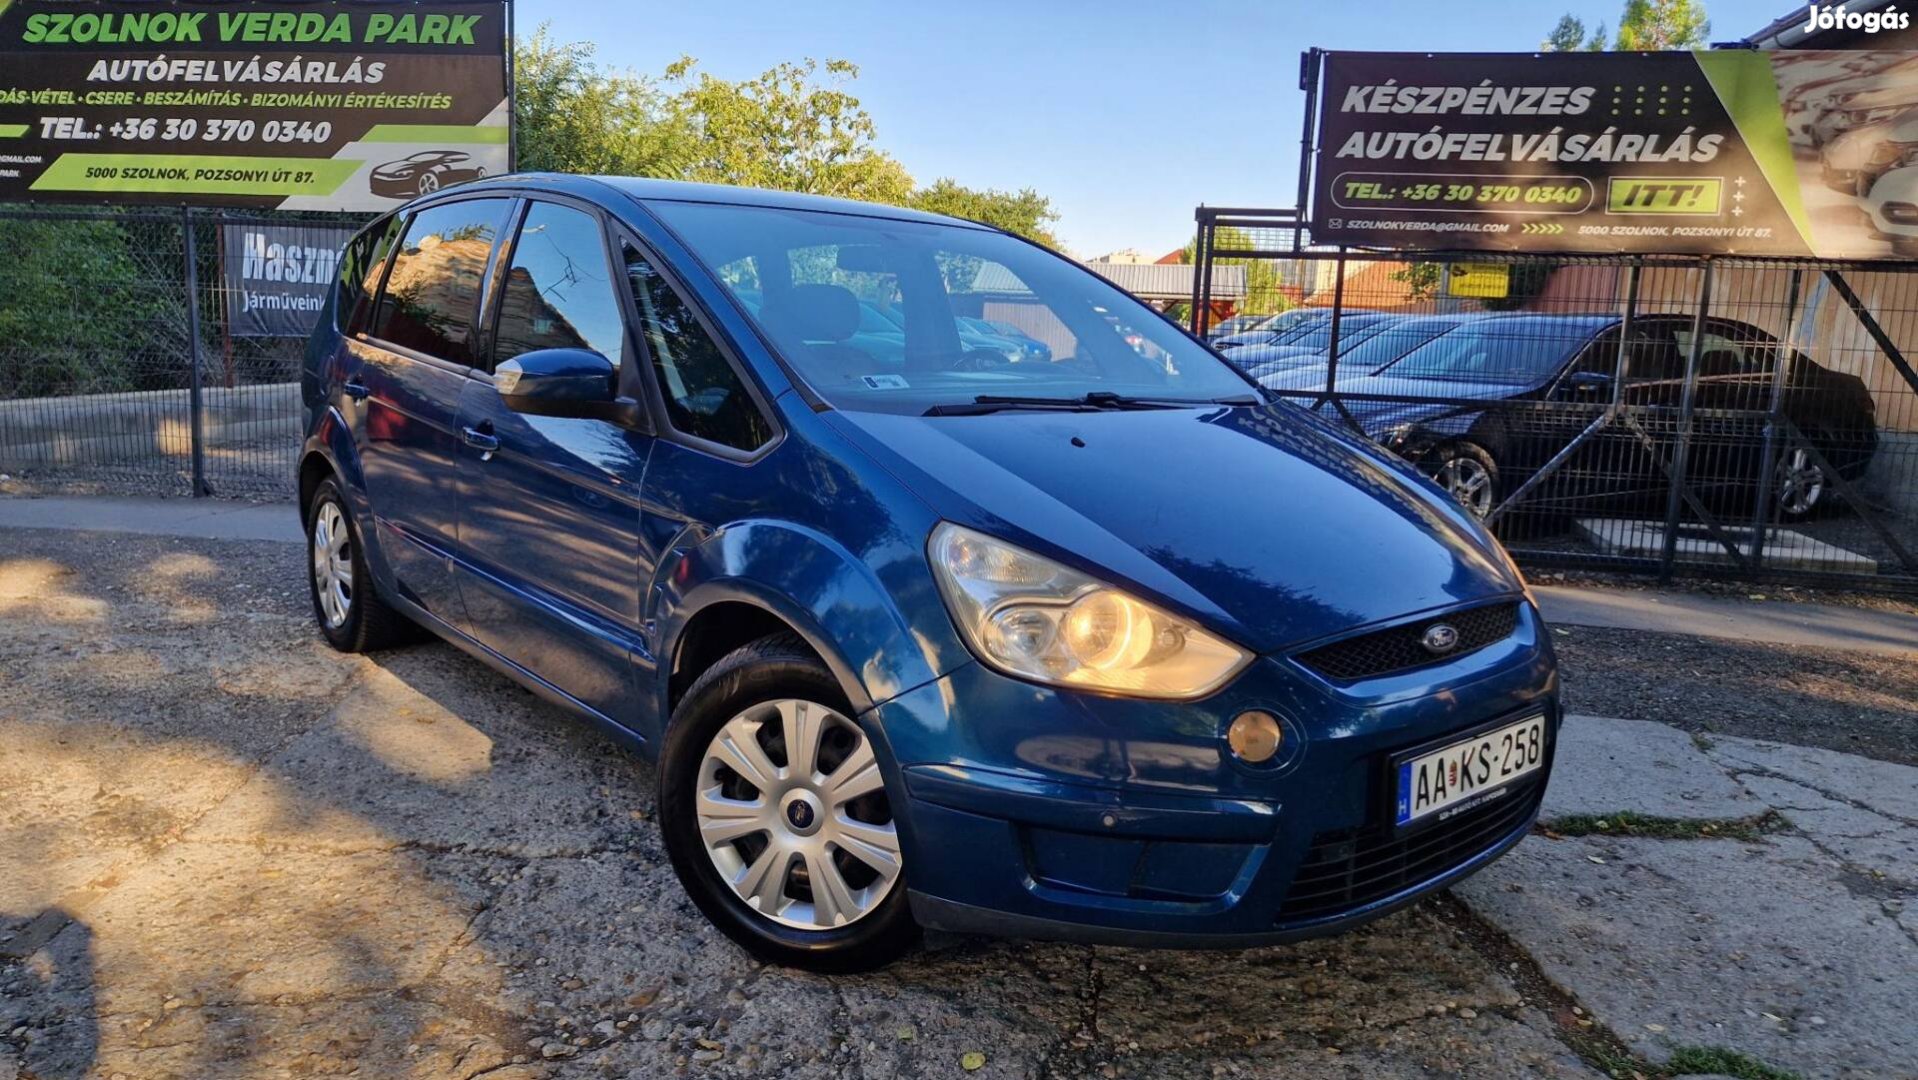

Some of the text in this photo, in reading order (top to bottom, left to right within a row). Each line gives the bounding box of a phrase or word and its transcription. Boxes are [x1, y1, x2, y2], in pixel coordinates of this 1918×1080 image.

[22, 12, 482, 45] SZOLNOK VERDA PARK
[86, 54, 387, 84] AUTÓFELVÁSÁRLÁS
[85, 91, 135, 105] CSERE
[143, 89, 242, 106] BESZÁMÍTÁS
[251, 91, 341, 108] BIZOMÁNYI
[344, 92, 452, 110] ÉRTÉKESÍTÉS
[1341, 78, 1597, 116] KÉSZPÉNZES
[40, 116, 333, 144] TEL.: +36 30 370 0340
[1335, 125, 1725, 163] AUTÓFELVÁSÁRLÁS
[85, 167, 315, 184] 5000 SZOLNOK, POZSONYI ÚT 87.
[1345, 182, 1582, 205] TEL.: +36 30 370 0340
[1623, 184, 1705, 208] ITT!
[1346, 219, 1510, 234] SZOLNOKVERDA@GMAIL.COM
[1578, 225, 1610, 236] 5000
[1672, 227, 1735, 238] POZSONYI
[1736, 225, 1755, 238] ÚT
[1415, 757, 1447, 811] AA
[1460, 724, 1541, 793] KS-258
